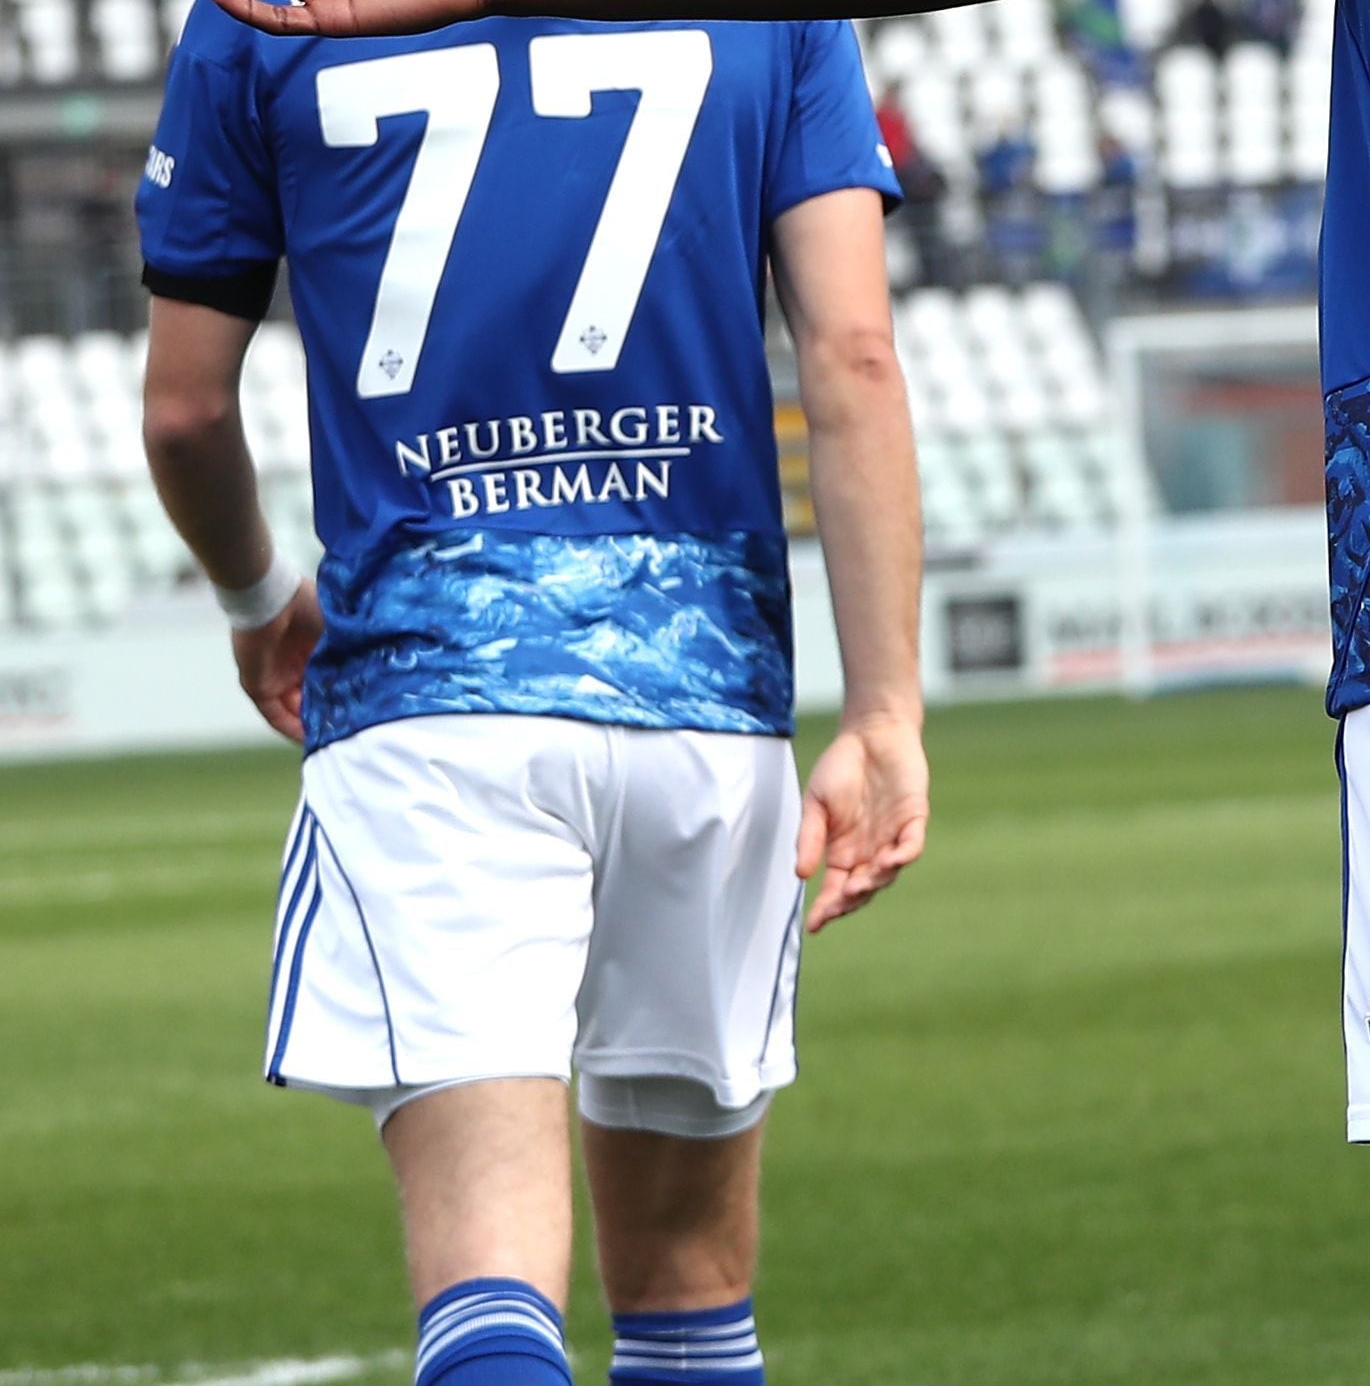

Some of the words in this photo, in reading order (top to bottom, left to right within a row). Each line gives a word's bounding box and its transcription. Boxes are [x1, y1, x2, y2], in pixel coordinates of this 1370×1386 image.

[315, 29, 713, 399] 77
[395, 405, 724, 476] NEUBERGER
[448, 460, 672, 519] BERMAN
